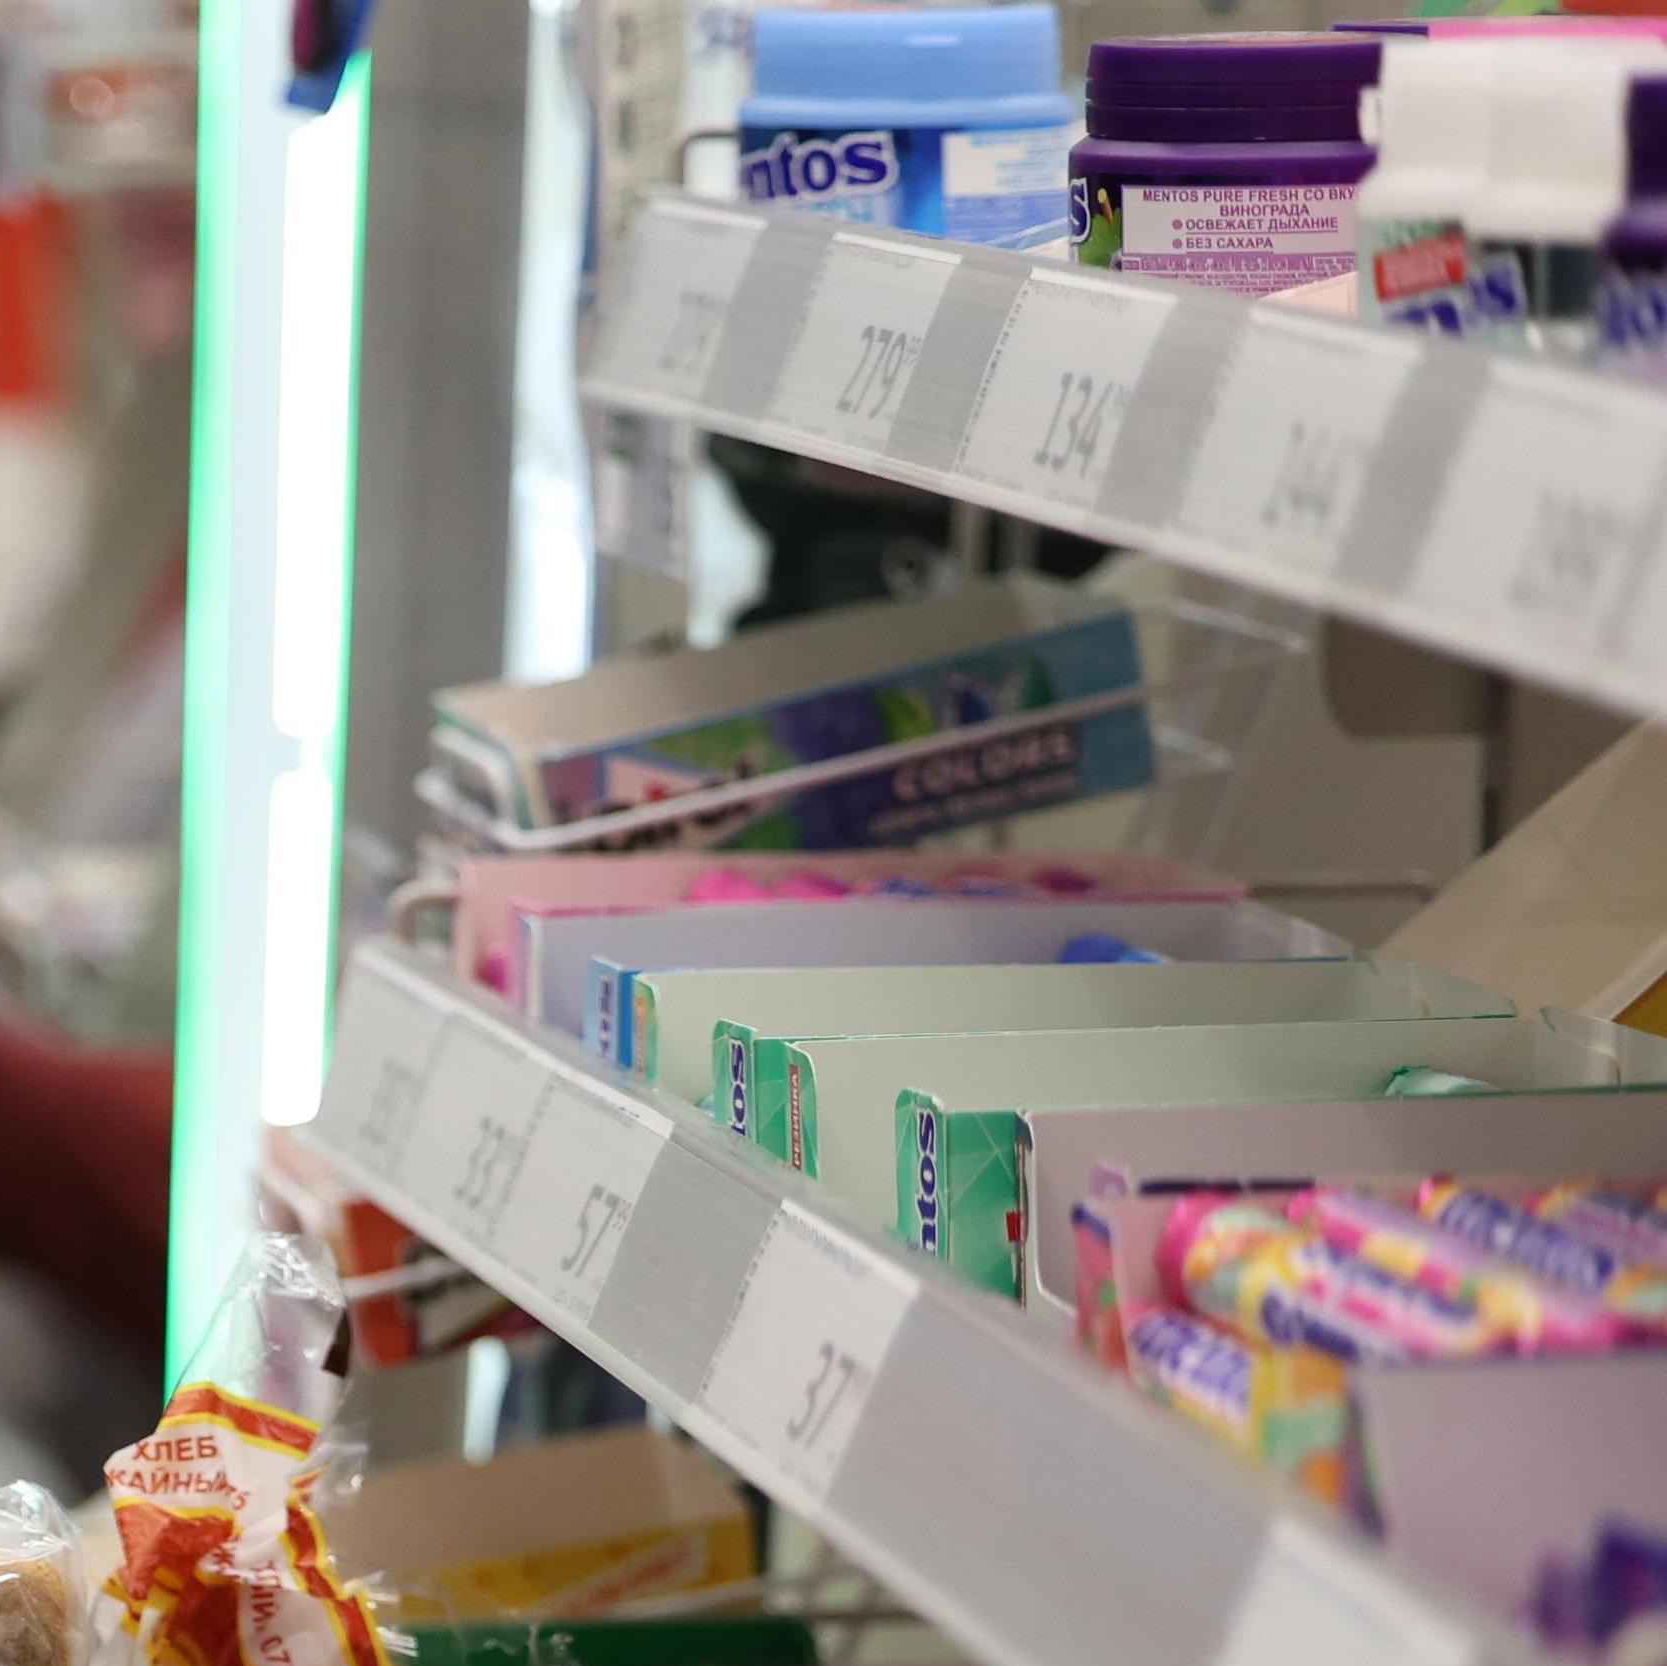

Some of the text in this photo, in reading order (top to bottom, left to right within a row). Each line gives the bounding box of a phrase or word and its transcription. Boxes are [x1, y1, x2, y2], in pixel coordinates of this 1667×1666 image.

[1142, 189, 1199, 202] MENTOS
[1203, 189, 1245, 202] PURE
[1249, 189, 1299, 202] FRESH
[1303, 188, 1324, 201] СО
[1219, 204, 1311, 217] ВИНОГРАДА
[1185, 217, 1338, 231] ОСВЕЖАЕТ ДЫХАНИЕ
[1186, 237, 1274, 249] БЕЗ САХАРА
[132, 1436, 218, 1462] ХЛЕБ
